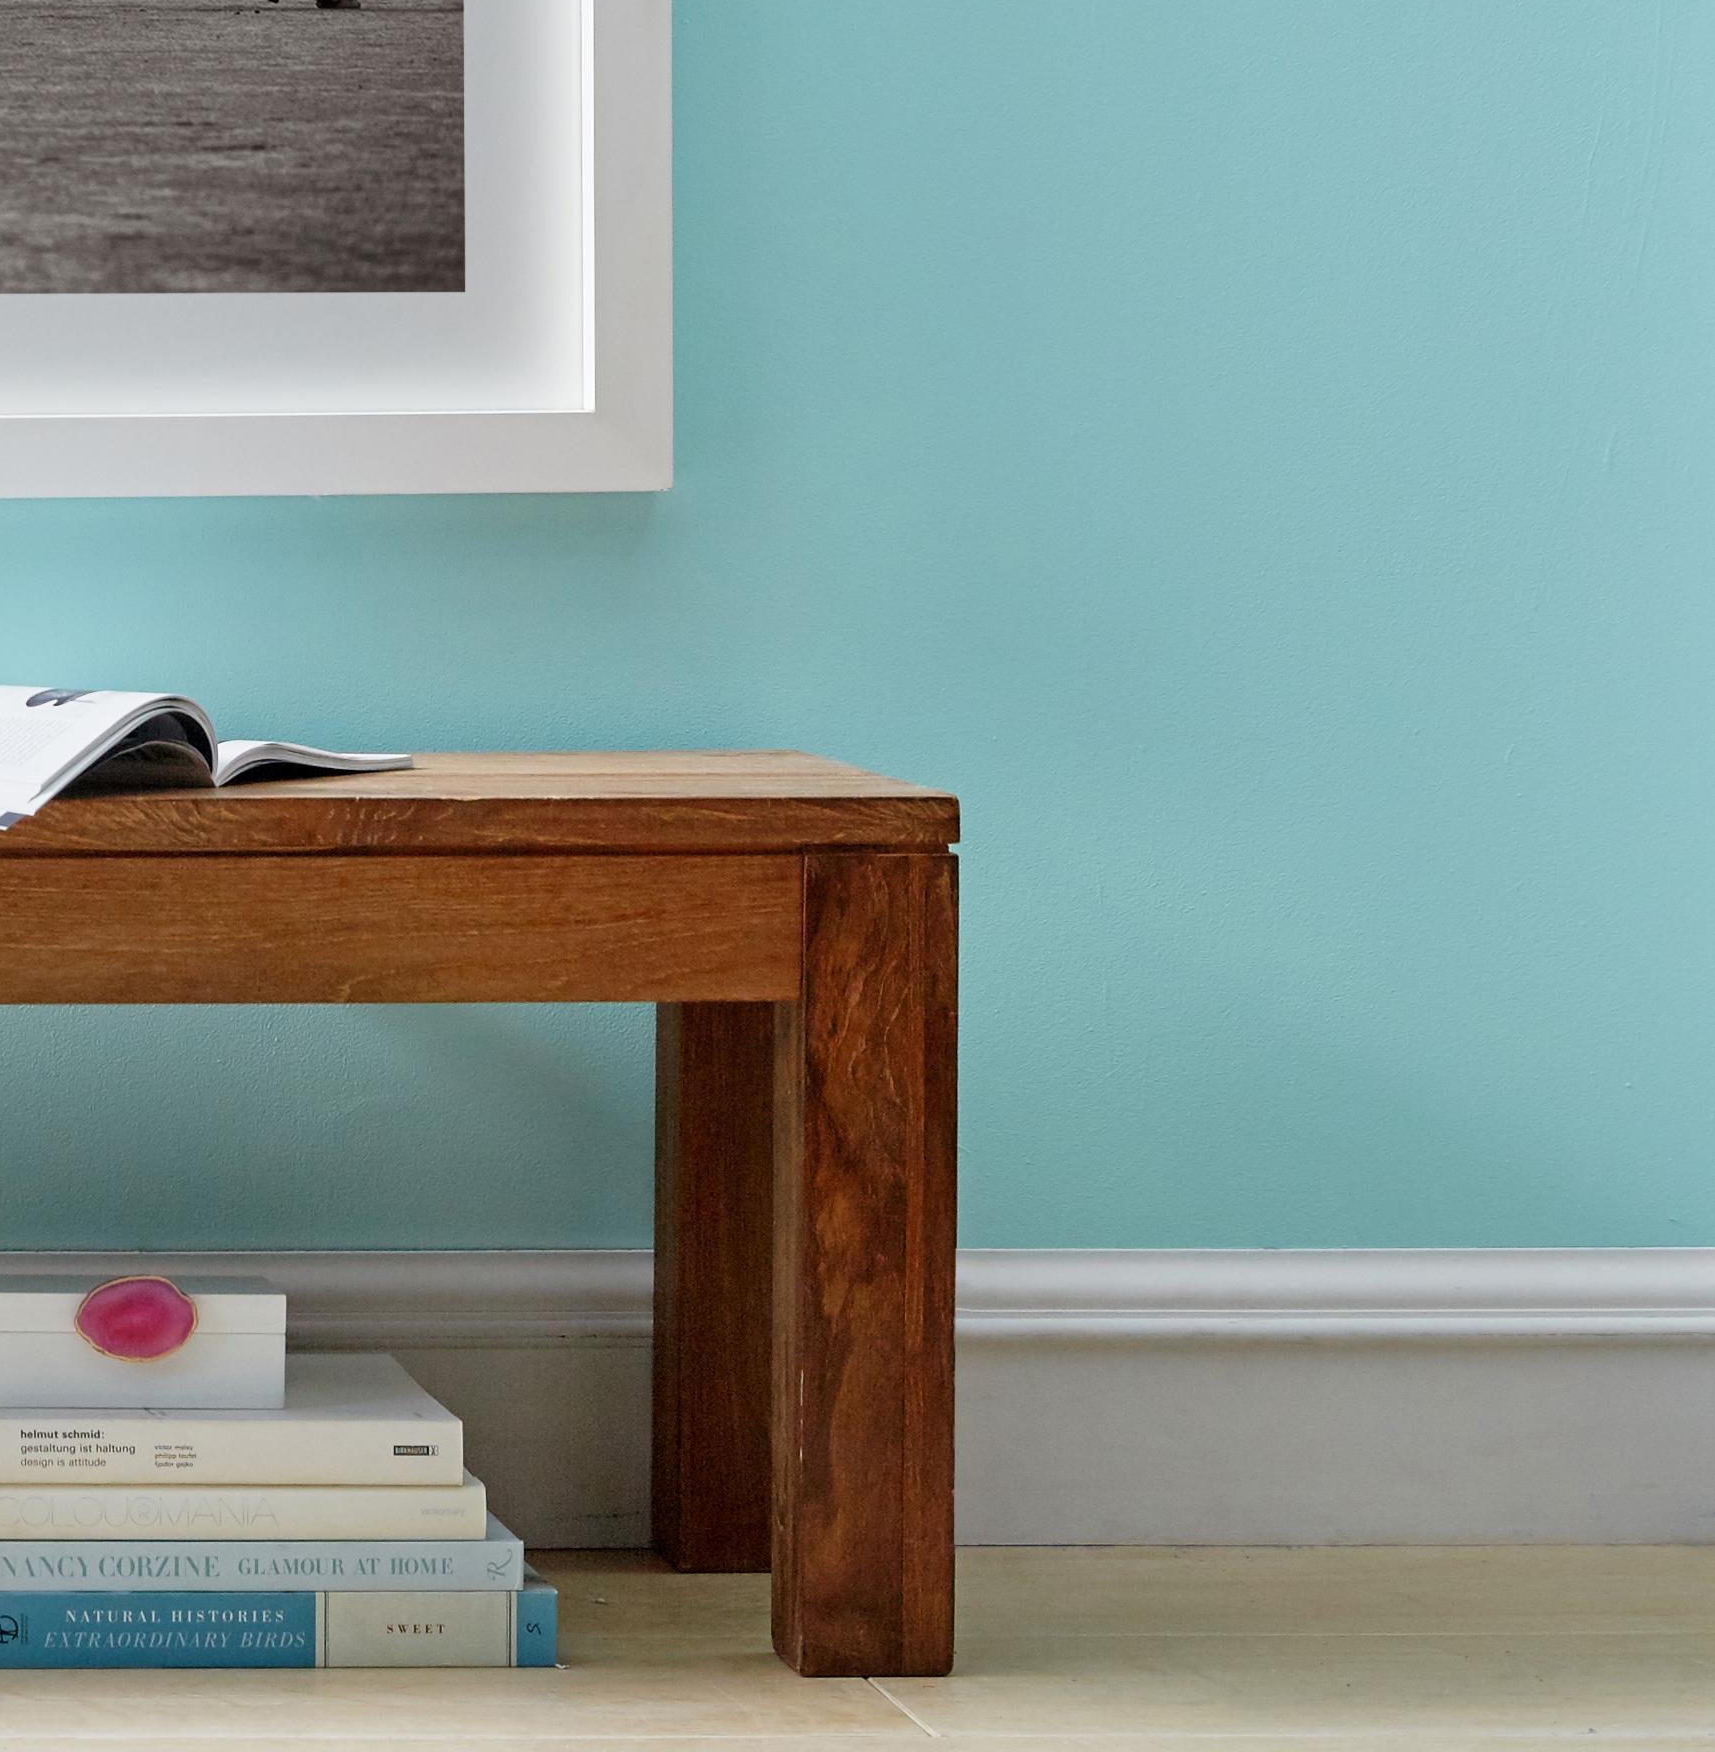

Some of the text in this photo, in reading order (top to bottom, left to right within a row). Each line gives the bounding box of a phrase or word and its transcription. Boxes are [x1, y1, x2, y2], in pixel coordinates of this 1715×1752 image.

[20, 1430, 105, 1439] helmut schmid:
[20, 1444, 136, 1455] gestaltung ist haltung
[20, 1458, 106, 1468] design is attitude
[2, 1556, 454, 1578] NANCY CORZINE GLAMOUR AT HOME
[65, 1609, 285, 1624] NATURAL HISTORIES
[386, 1623, 446, 1635] SWEET
[44, 1631, 306, 1648] EXTRAORDINARY BIRDS
